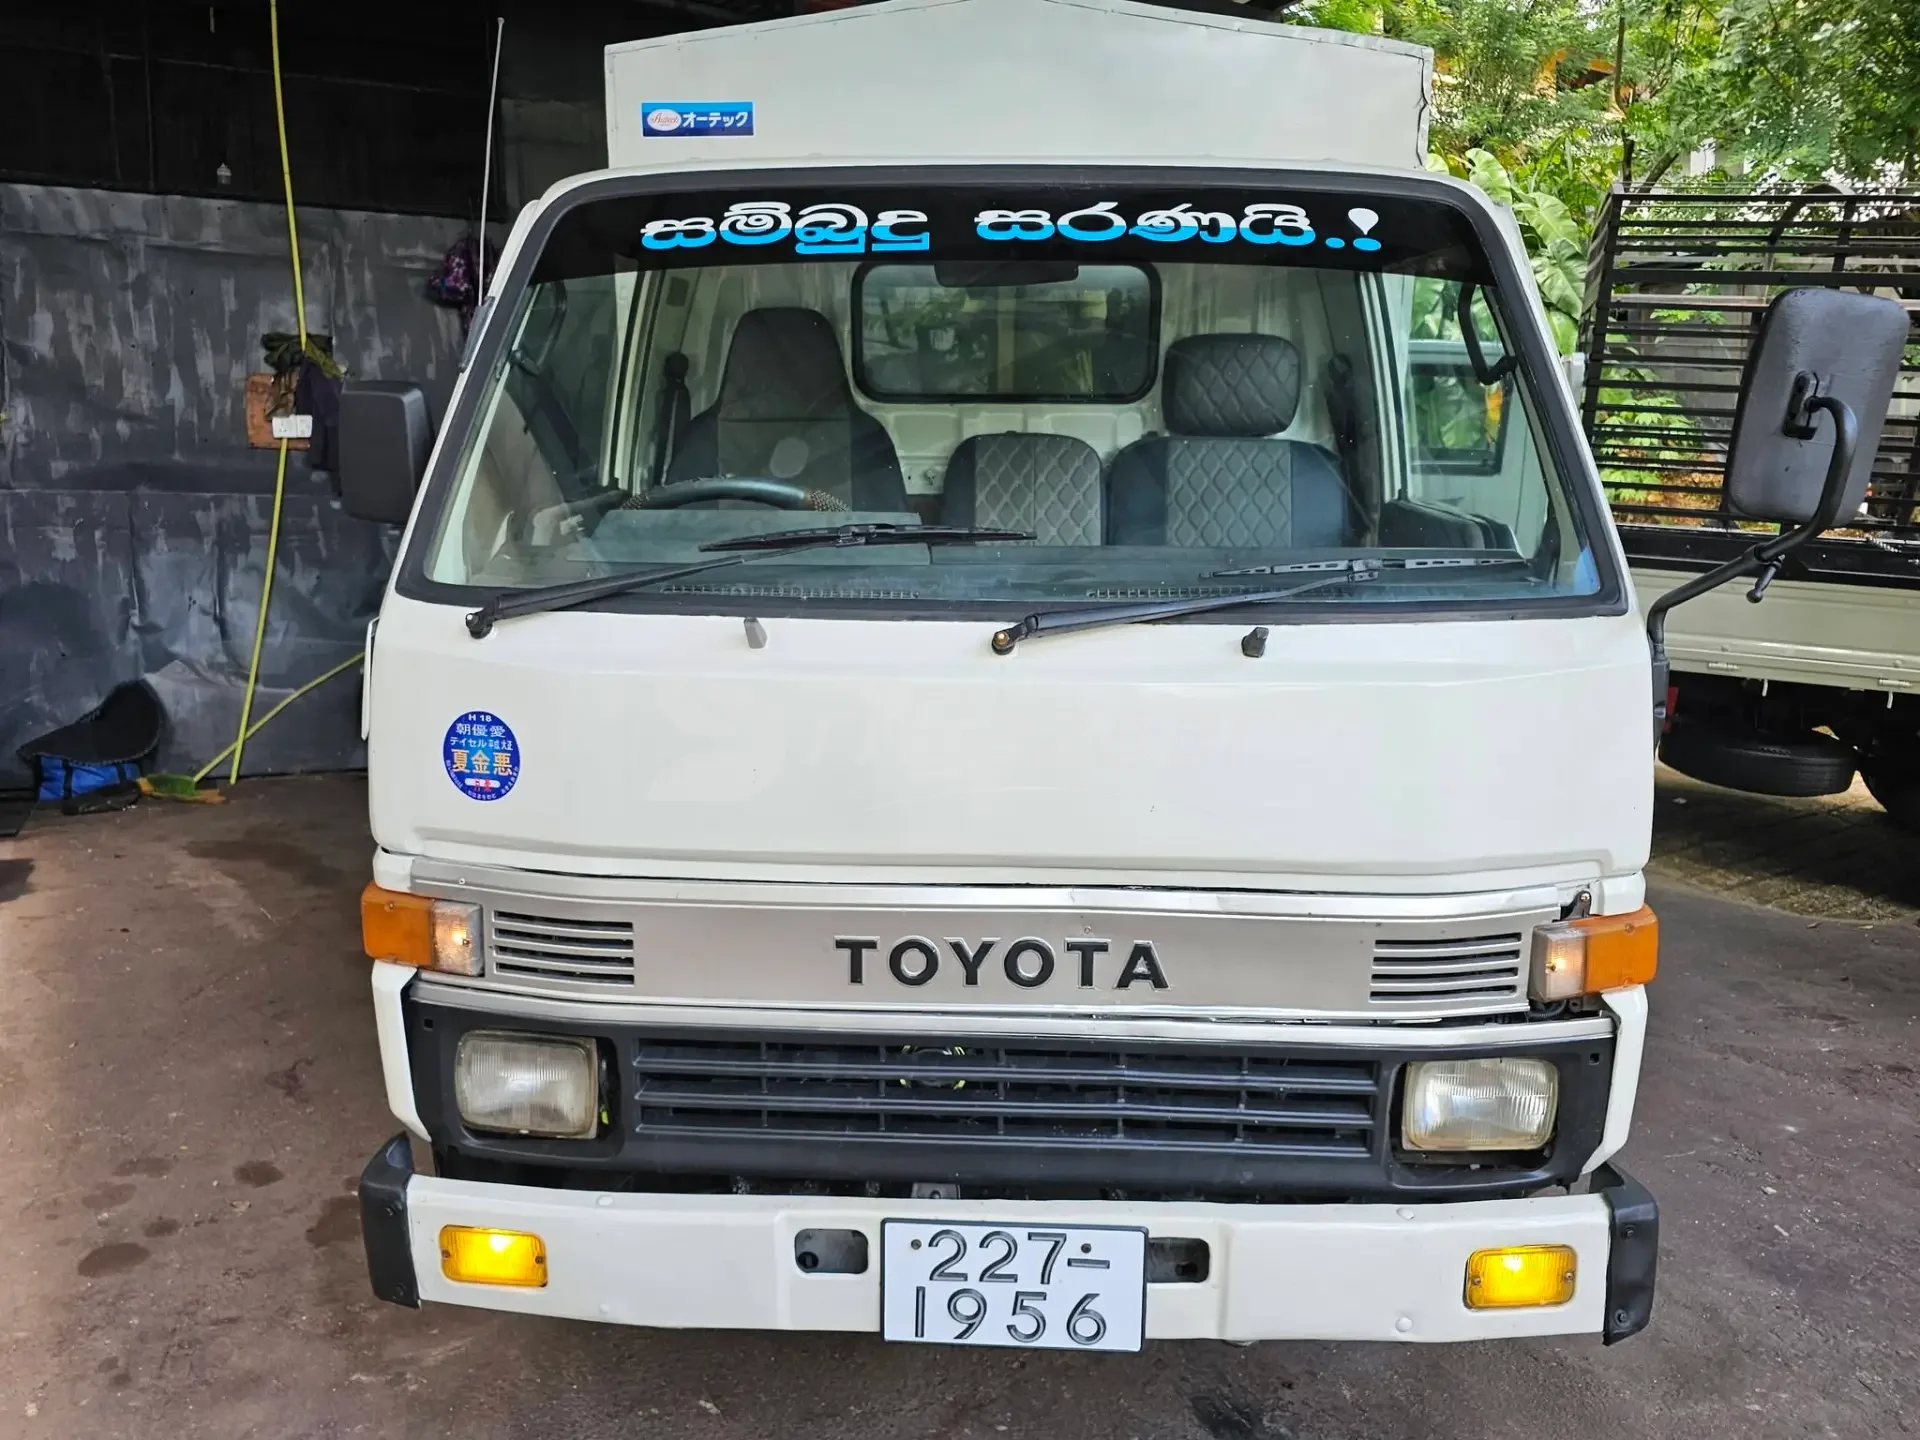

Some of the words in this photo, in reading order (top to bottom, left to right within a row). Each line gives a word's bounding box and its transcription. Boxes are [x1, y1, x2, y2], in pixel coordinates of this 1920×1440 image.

[682, 111, 748, 128] オーテック
[640, 201, 930, 255] සම්බුදු
[833, 935, 1171, 991] TOYOTA
[915, 1286, 1107, 1345] 1956
